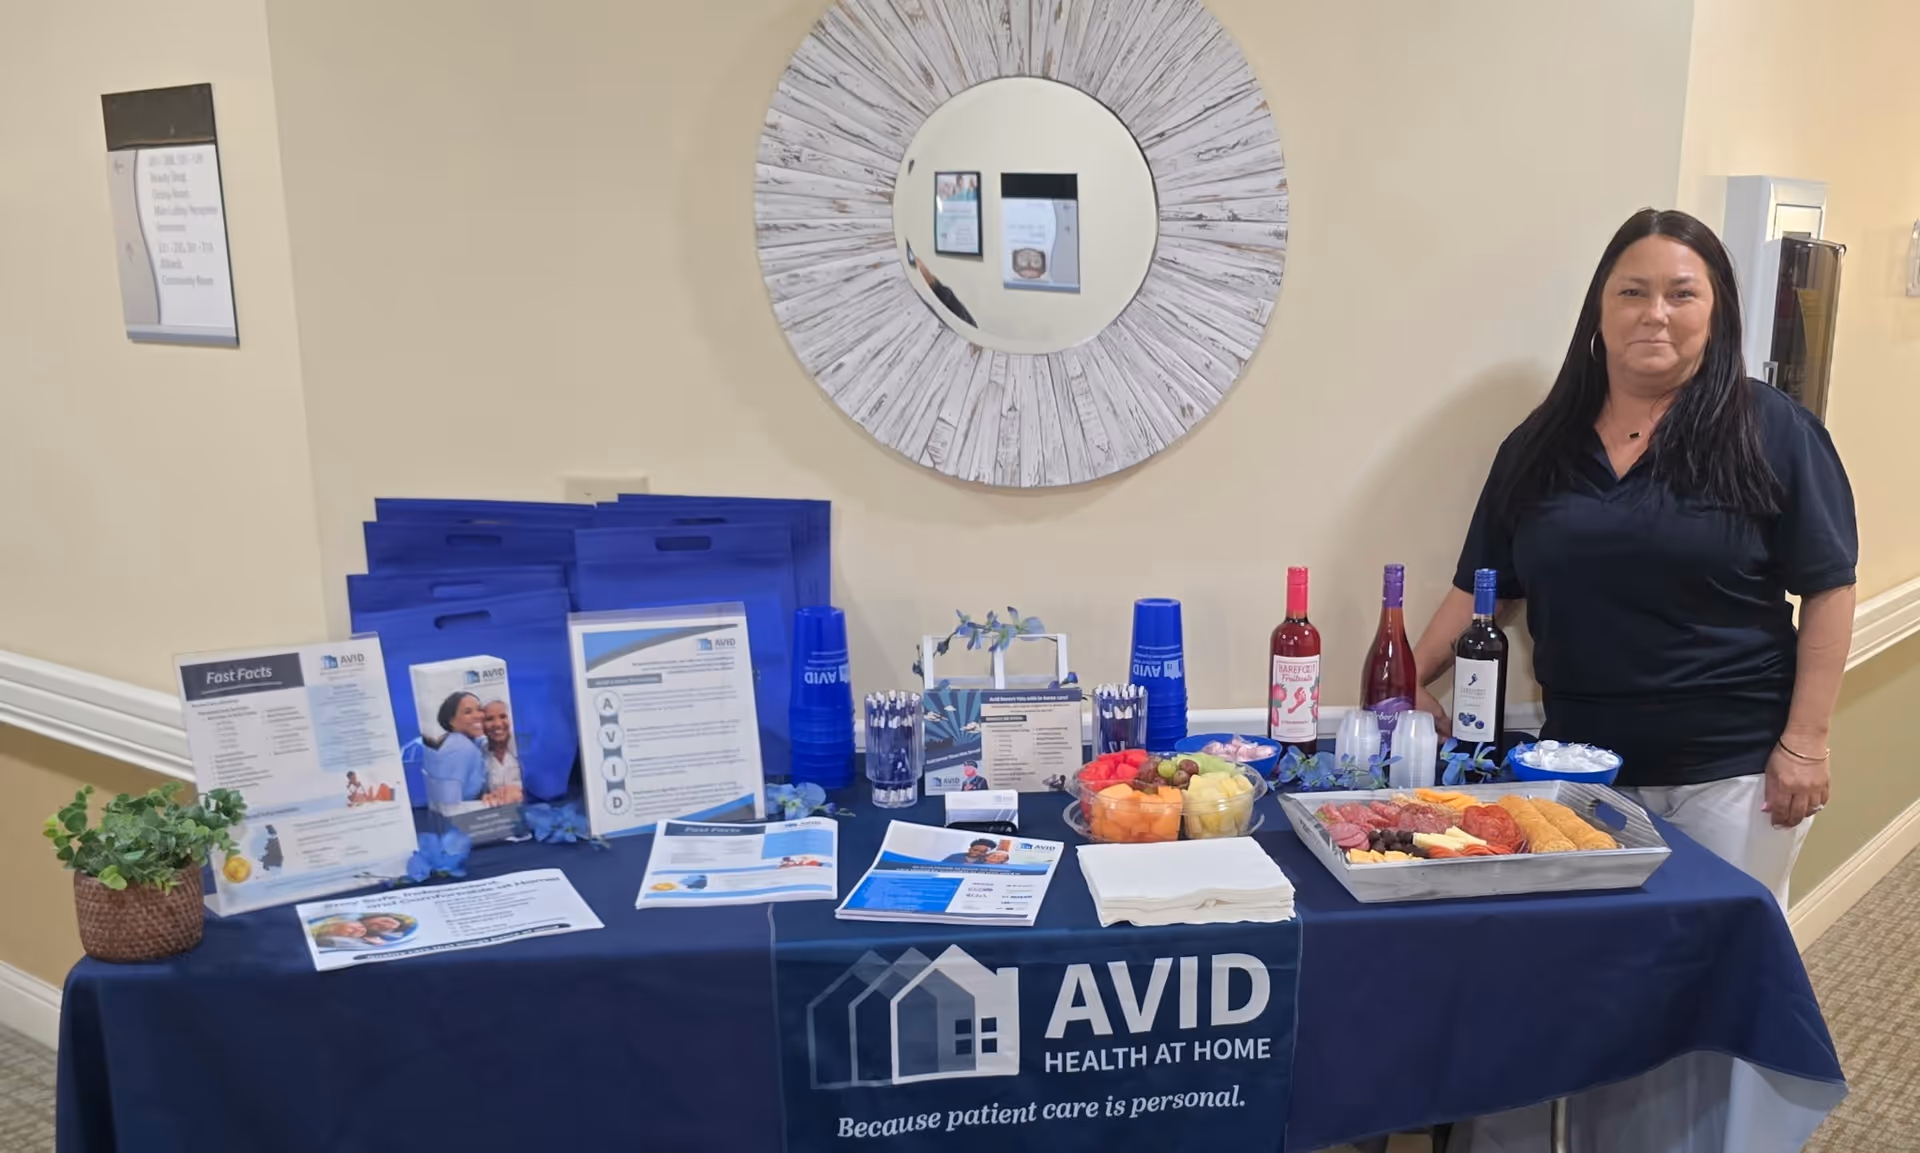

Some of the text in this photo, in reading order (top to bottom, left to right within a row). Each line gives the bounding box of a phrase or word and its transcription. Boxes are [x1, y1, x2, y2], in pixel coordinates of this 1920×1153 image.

[714, 638, 736, 648] AVID
[340, 653, 365, 666] AVID
[206, 666, 273, 685] Fast Facts
[482, 667, 505, 680] AVID
[1132, 663, 1161, 678] AVID
[804, 671, 837, 685] AVID
[603, 697, 614, 711] A
[605, 731, 616, 743] V
[942, 777, 960, 786] AVID
[613, 796, 623, 809] D
[1045, 953, 1271, 1039] AVID
[1045, 1037, 1272, 1074] HEALTH AT HOME
[837, 1084, 1246, 1138] Because patient care is personal.
